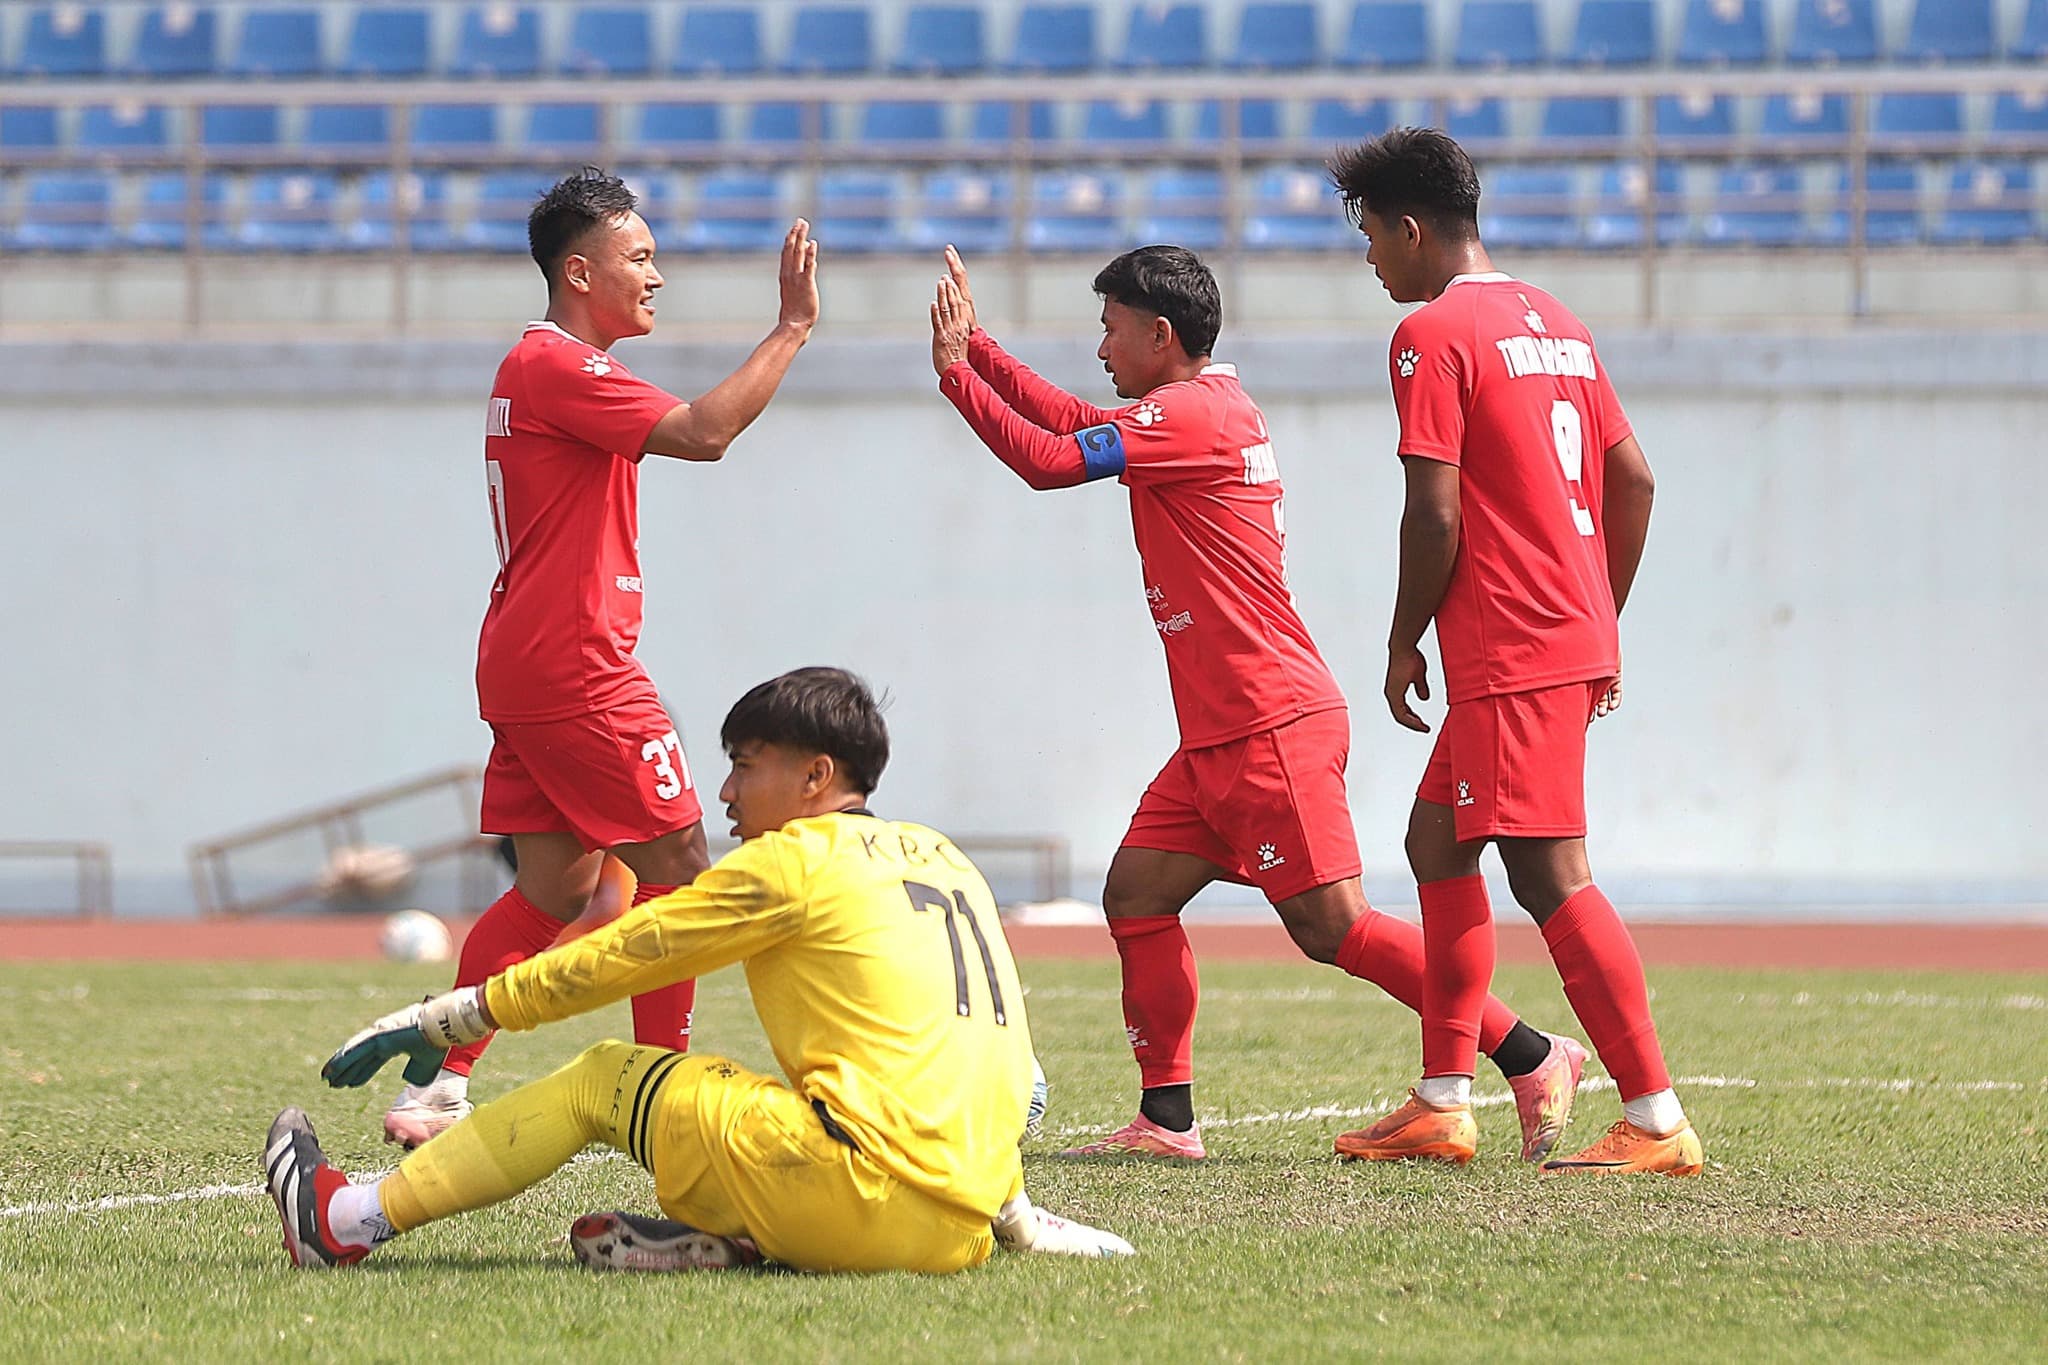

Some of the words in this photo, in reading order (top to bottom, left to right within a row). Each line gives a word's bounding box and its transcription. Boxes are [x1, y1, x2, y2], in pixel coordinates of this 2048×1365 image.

[1085, 428, 1117, 452] C
[641, 729, 694, 800] 37
[1258, 856, 1286, 871] KELME
[902, 879, 1007, 1027] 71
[609, 1049, 645, 1135] SELECT
